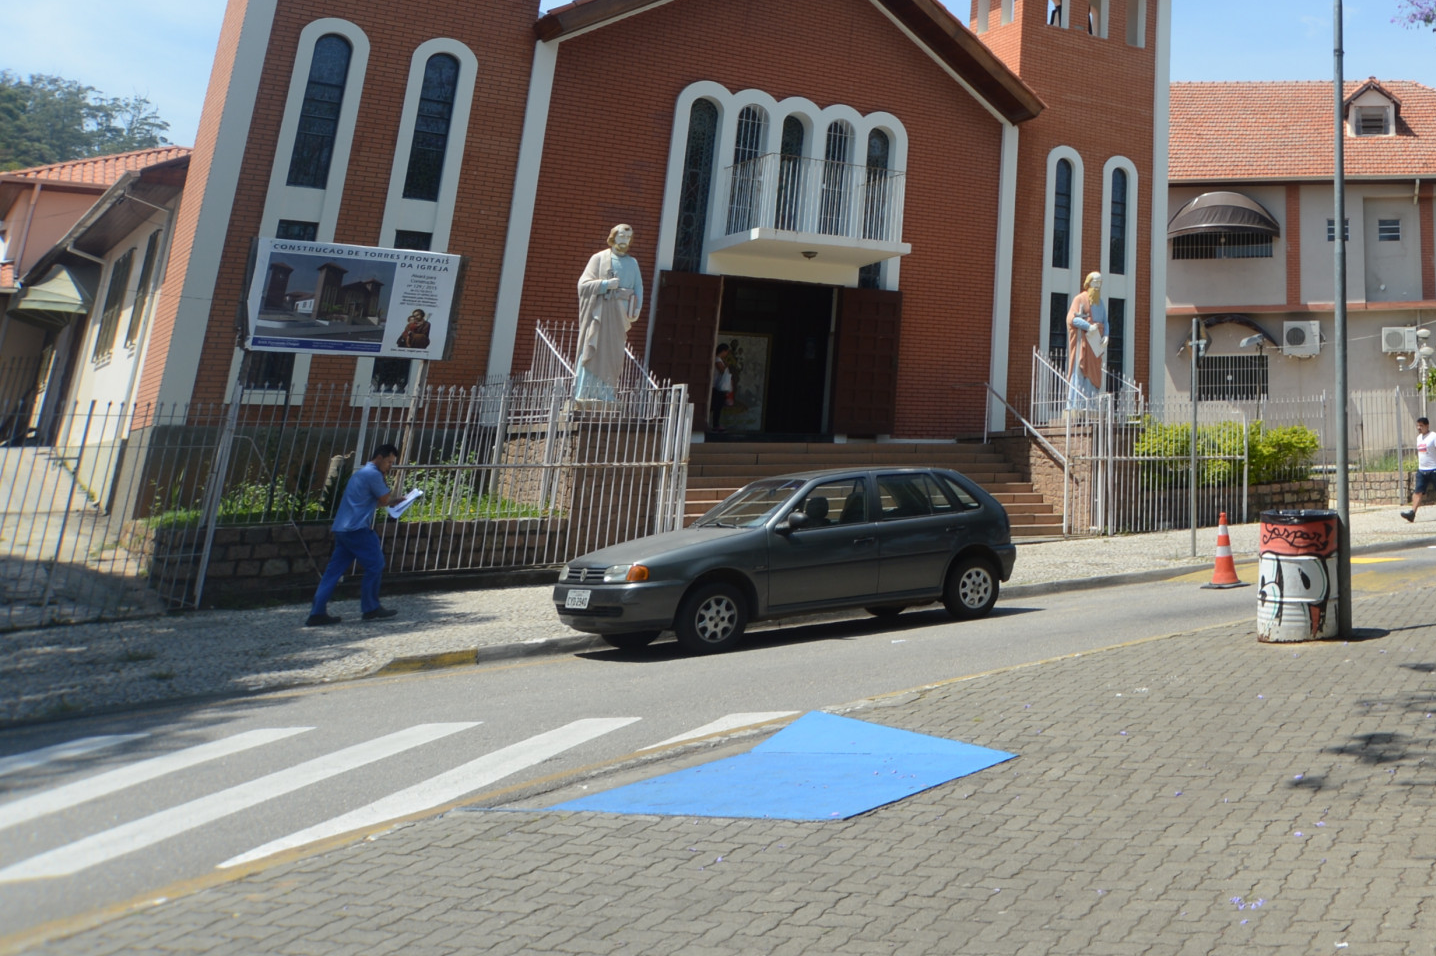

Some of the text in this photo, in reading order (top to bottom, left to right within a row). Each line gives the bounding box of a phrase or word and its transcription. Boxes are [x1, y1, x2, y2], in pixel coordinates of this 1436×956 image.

[363, 251, 400, 260] TORRES
[404, 255, 449, 264] FRONTAIS
[417, 264, 448, 272] IGREJA
